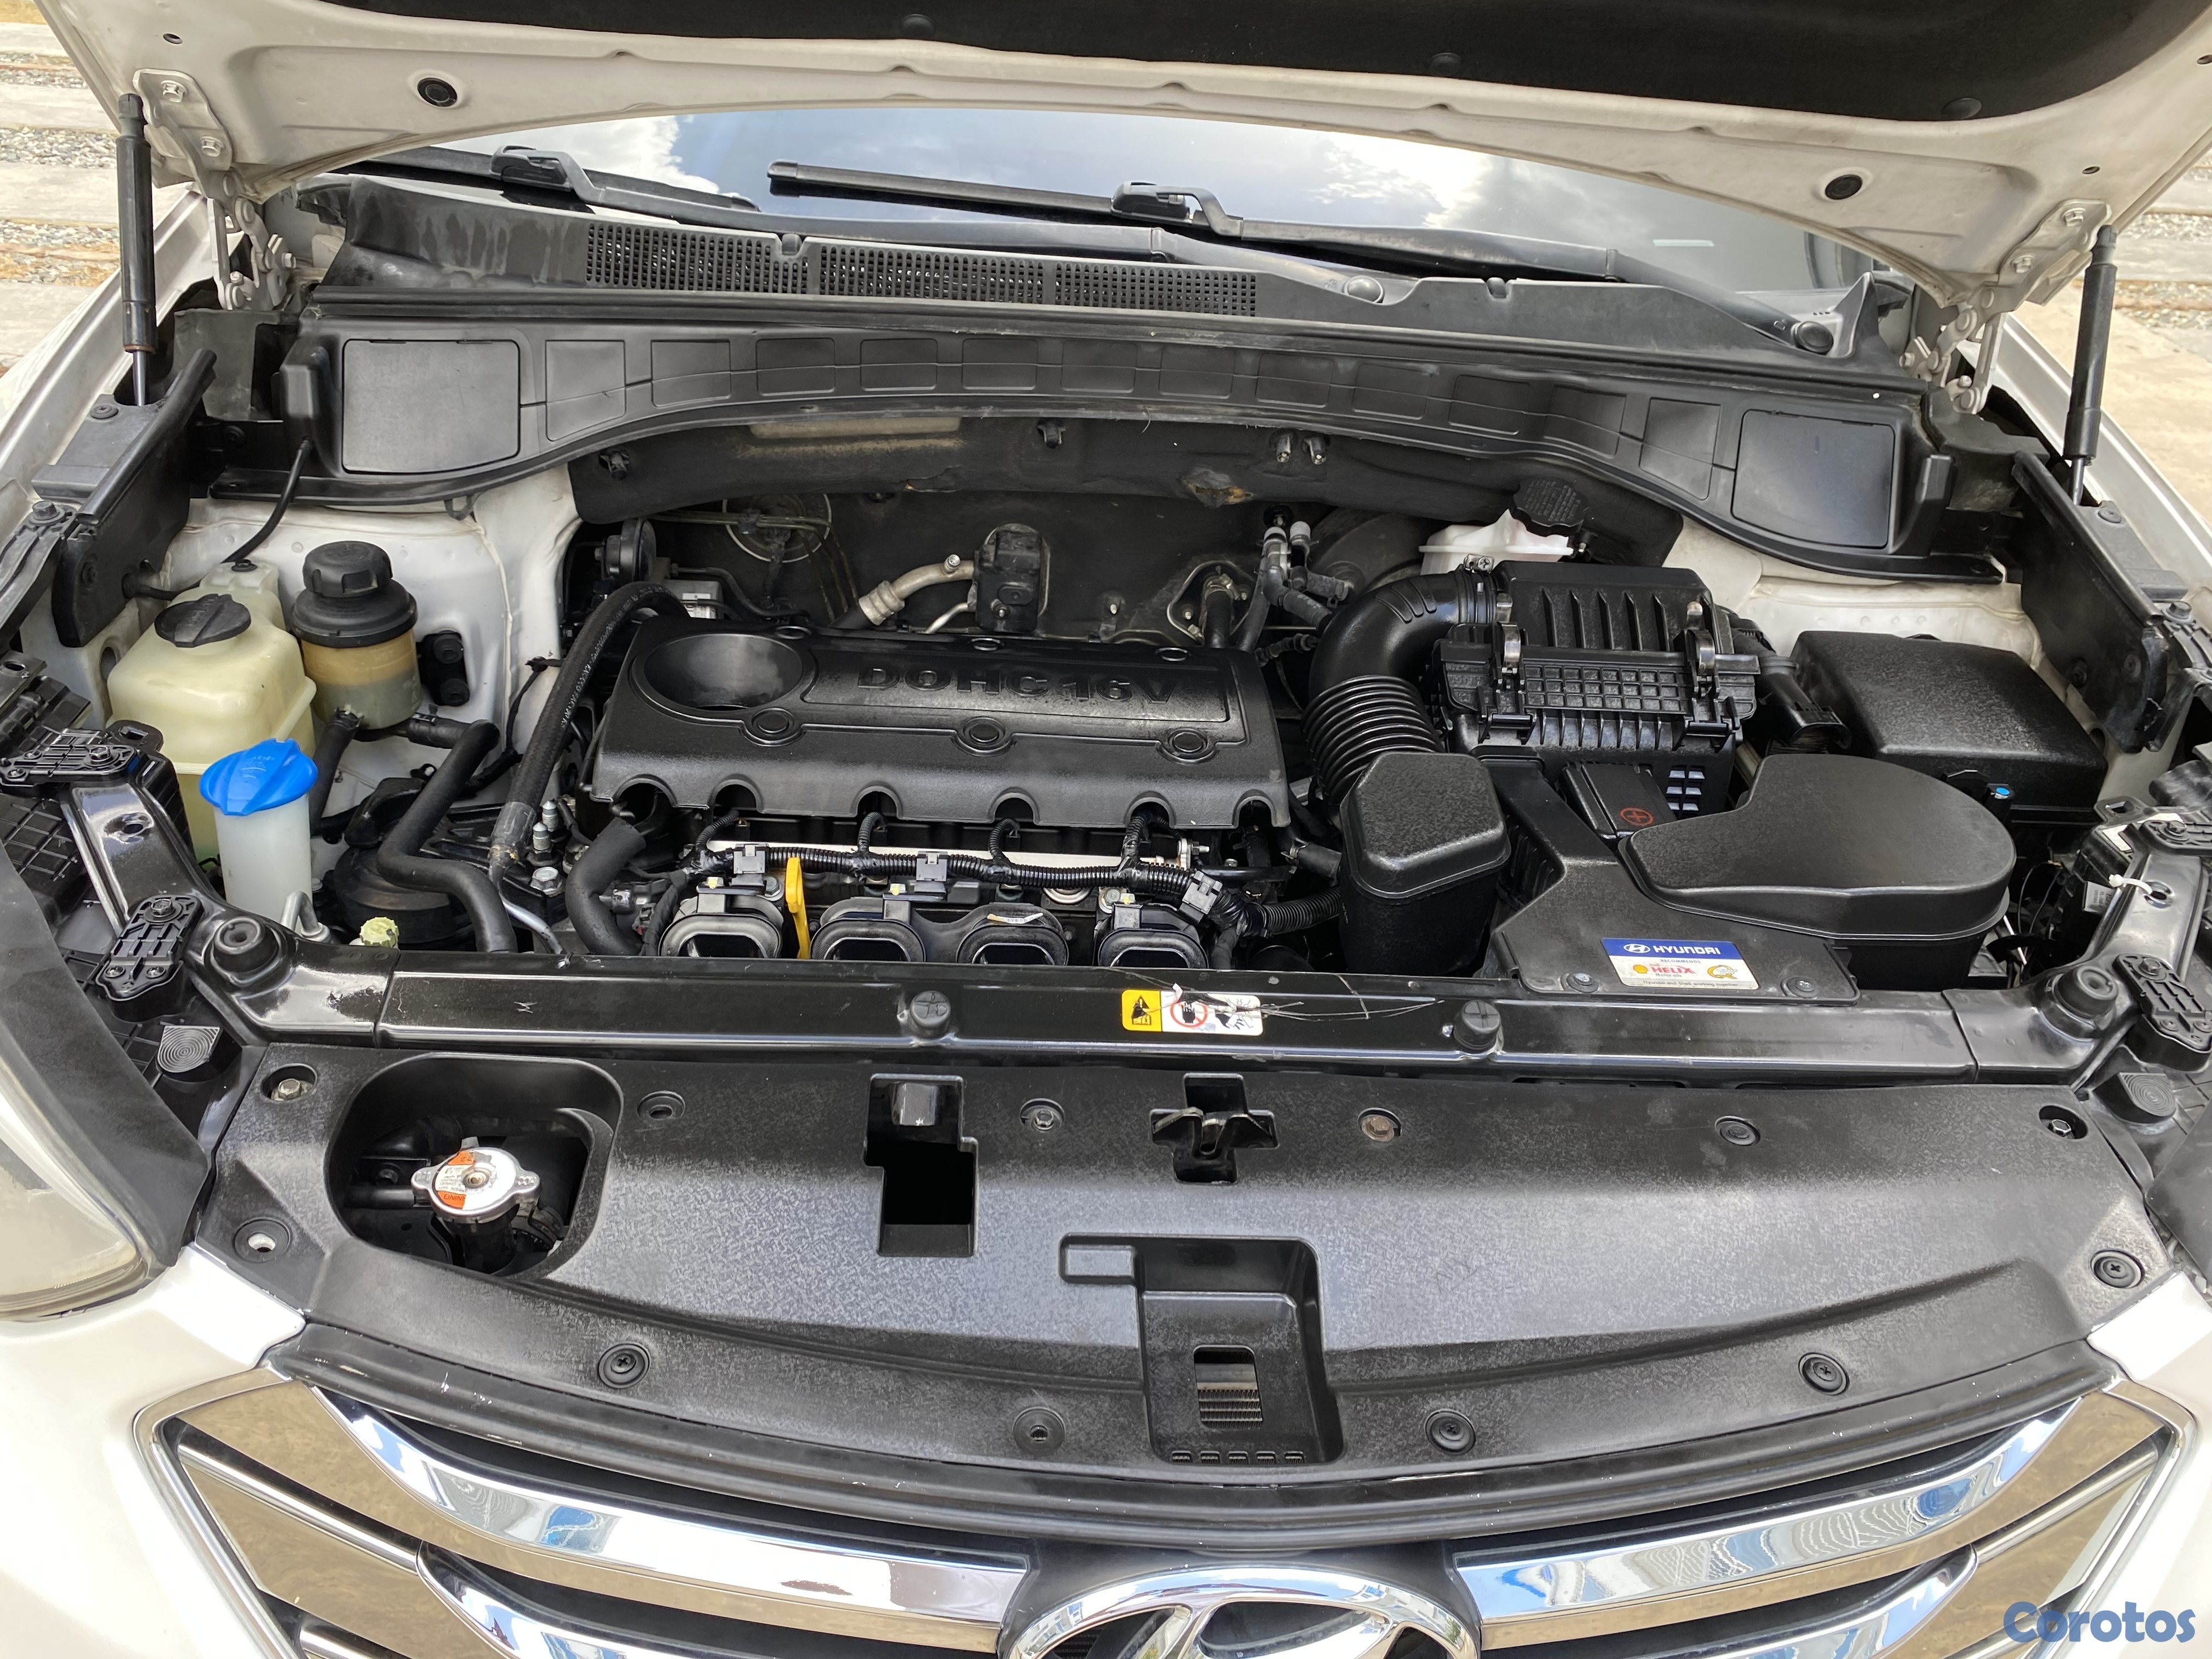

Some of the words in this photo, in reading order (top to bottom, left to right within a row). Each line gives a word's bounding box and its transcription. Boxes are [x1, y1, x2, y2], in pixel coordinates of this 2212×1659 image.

[857, 666, 1049, 697] DOHC
[1061, 675, 1179, 704] 16V
[1653, 945, 1721, 955] HYUNDAI
[1651, 966, 1696, 974] HELIX
